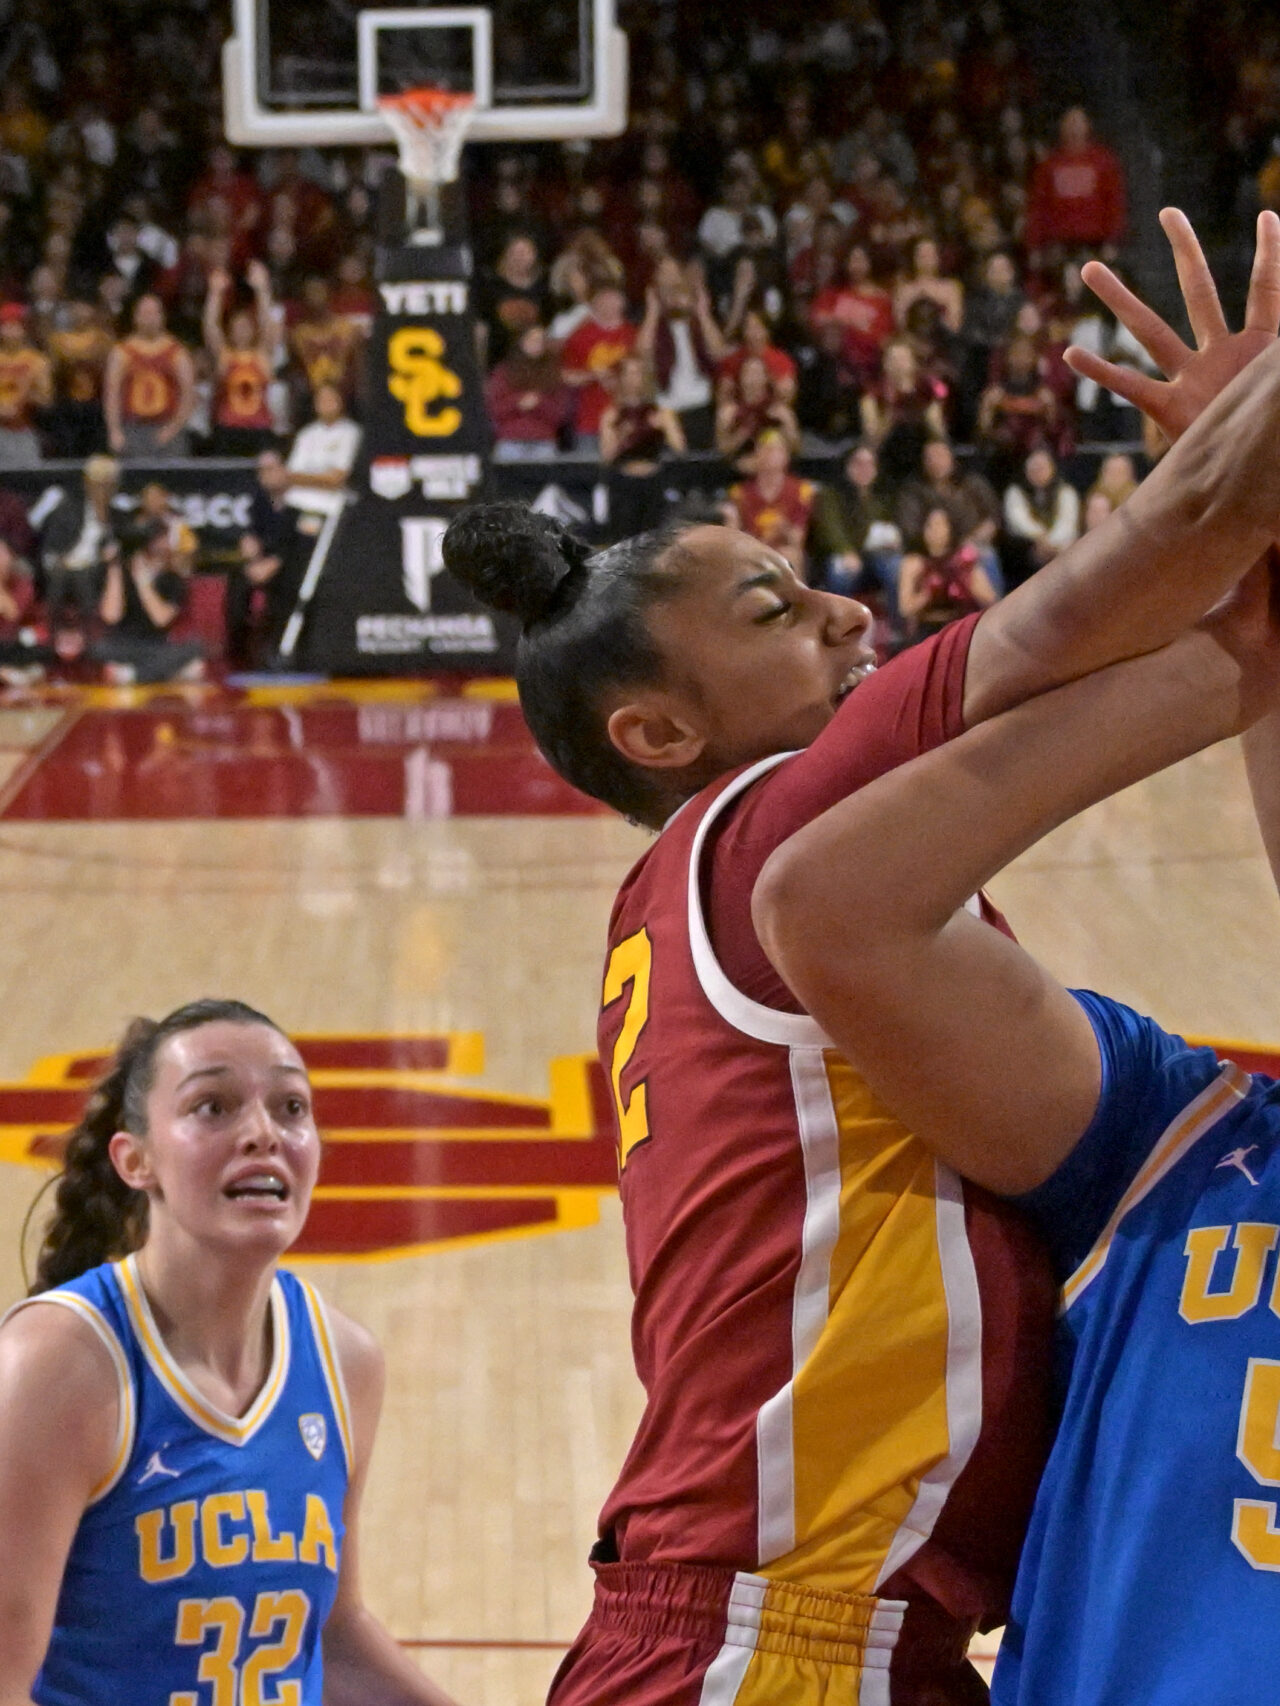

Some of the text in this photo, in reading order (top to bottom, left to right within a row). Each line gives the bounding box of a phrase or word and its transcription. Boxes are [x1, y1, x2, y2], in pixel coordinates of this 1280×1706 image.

[379, 281, 467, 315] YETI
[135, 1489, 338, 1584] UCLA
[169, 1589, 311, 1706] 32
